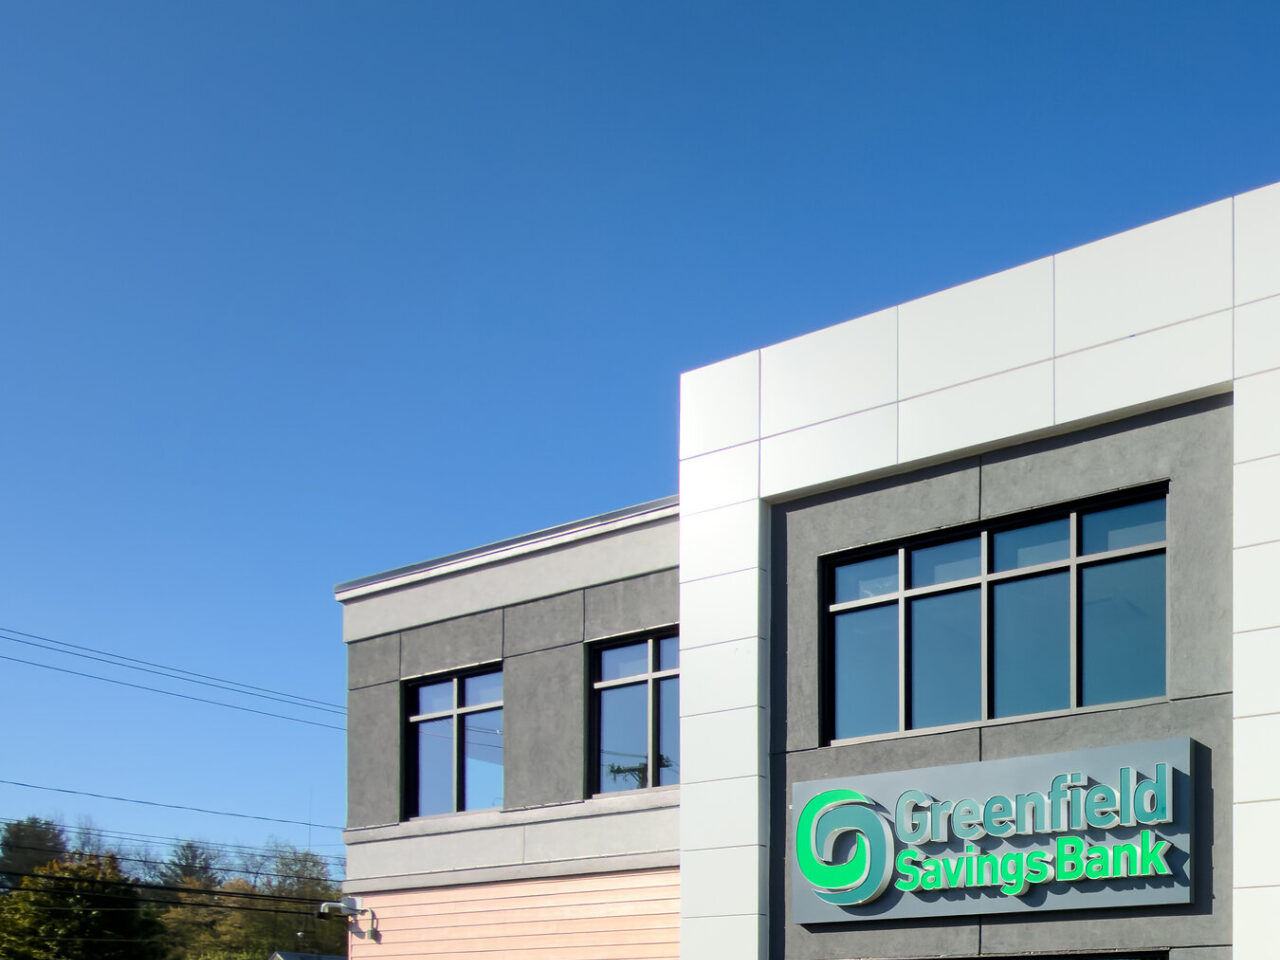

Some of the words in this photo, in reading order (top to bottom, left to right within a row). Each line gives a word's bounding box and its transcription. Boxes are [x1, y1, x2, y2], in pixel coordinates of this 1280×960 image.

[895, 762, 1173, 844] Greenfield
[895, 845, 1054, 896] Savings
[1055, 829, 1173, 882] Bank
